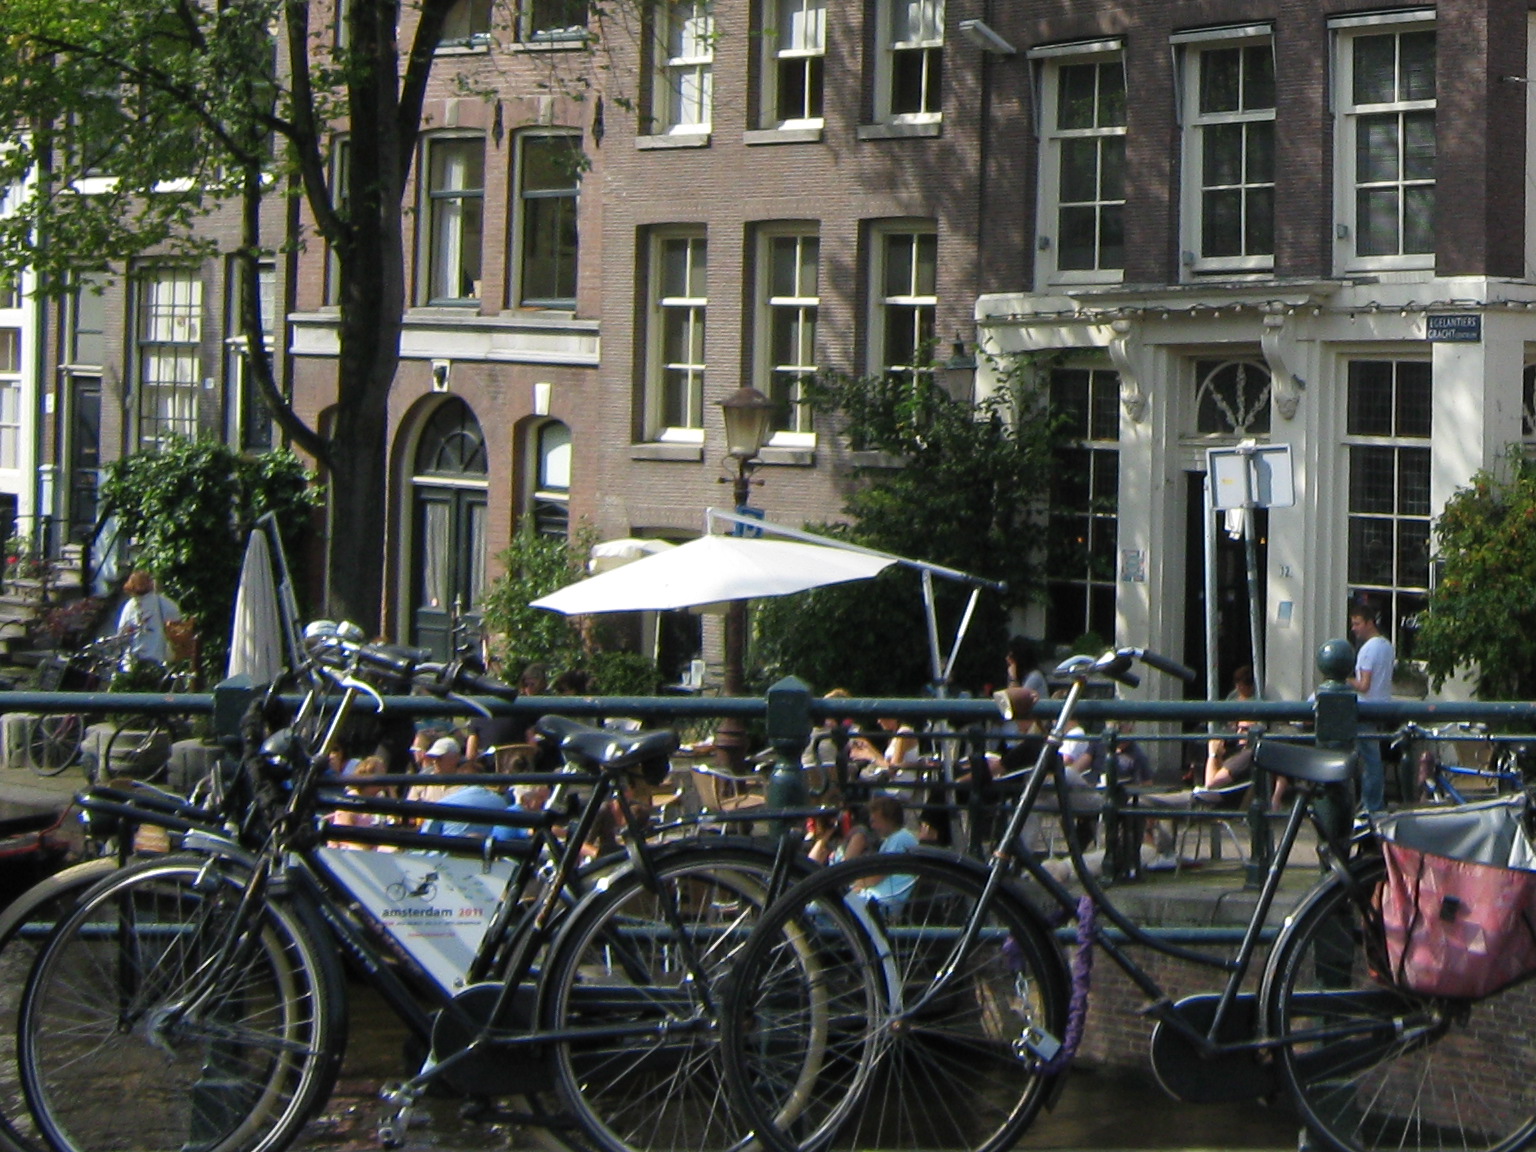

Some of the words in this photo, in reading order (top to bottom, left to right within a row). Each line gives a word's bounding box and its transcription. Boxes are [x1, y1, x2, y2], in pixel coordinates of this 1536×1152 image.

[1430, 316, 1476, 328] EGELANTIERS
[1428, 329, 1456, 339] GRACHT
[382, 907, 453, 917] amsterdam
[459, 909, 483, 917] 2011
